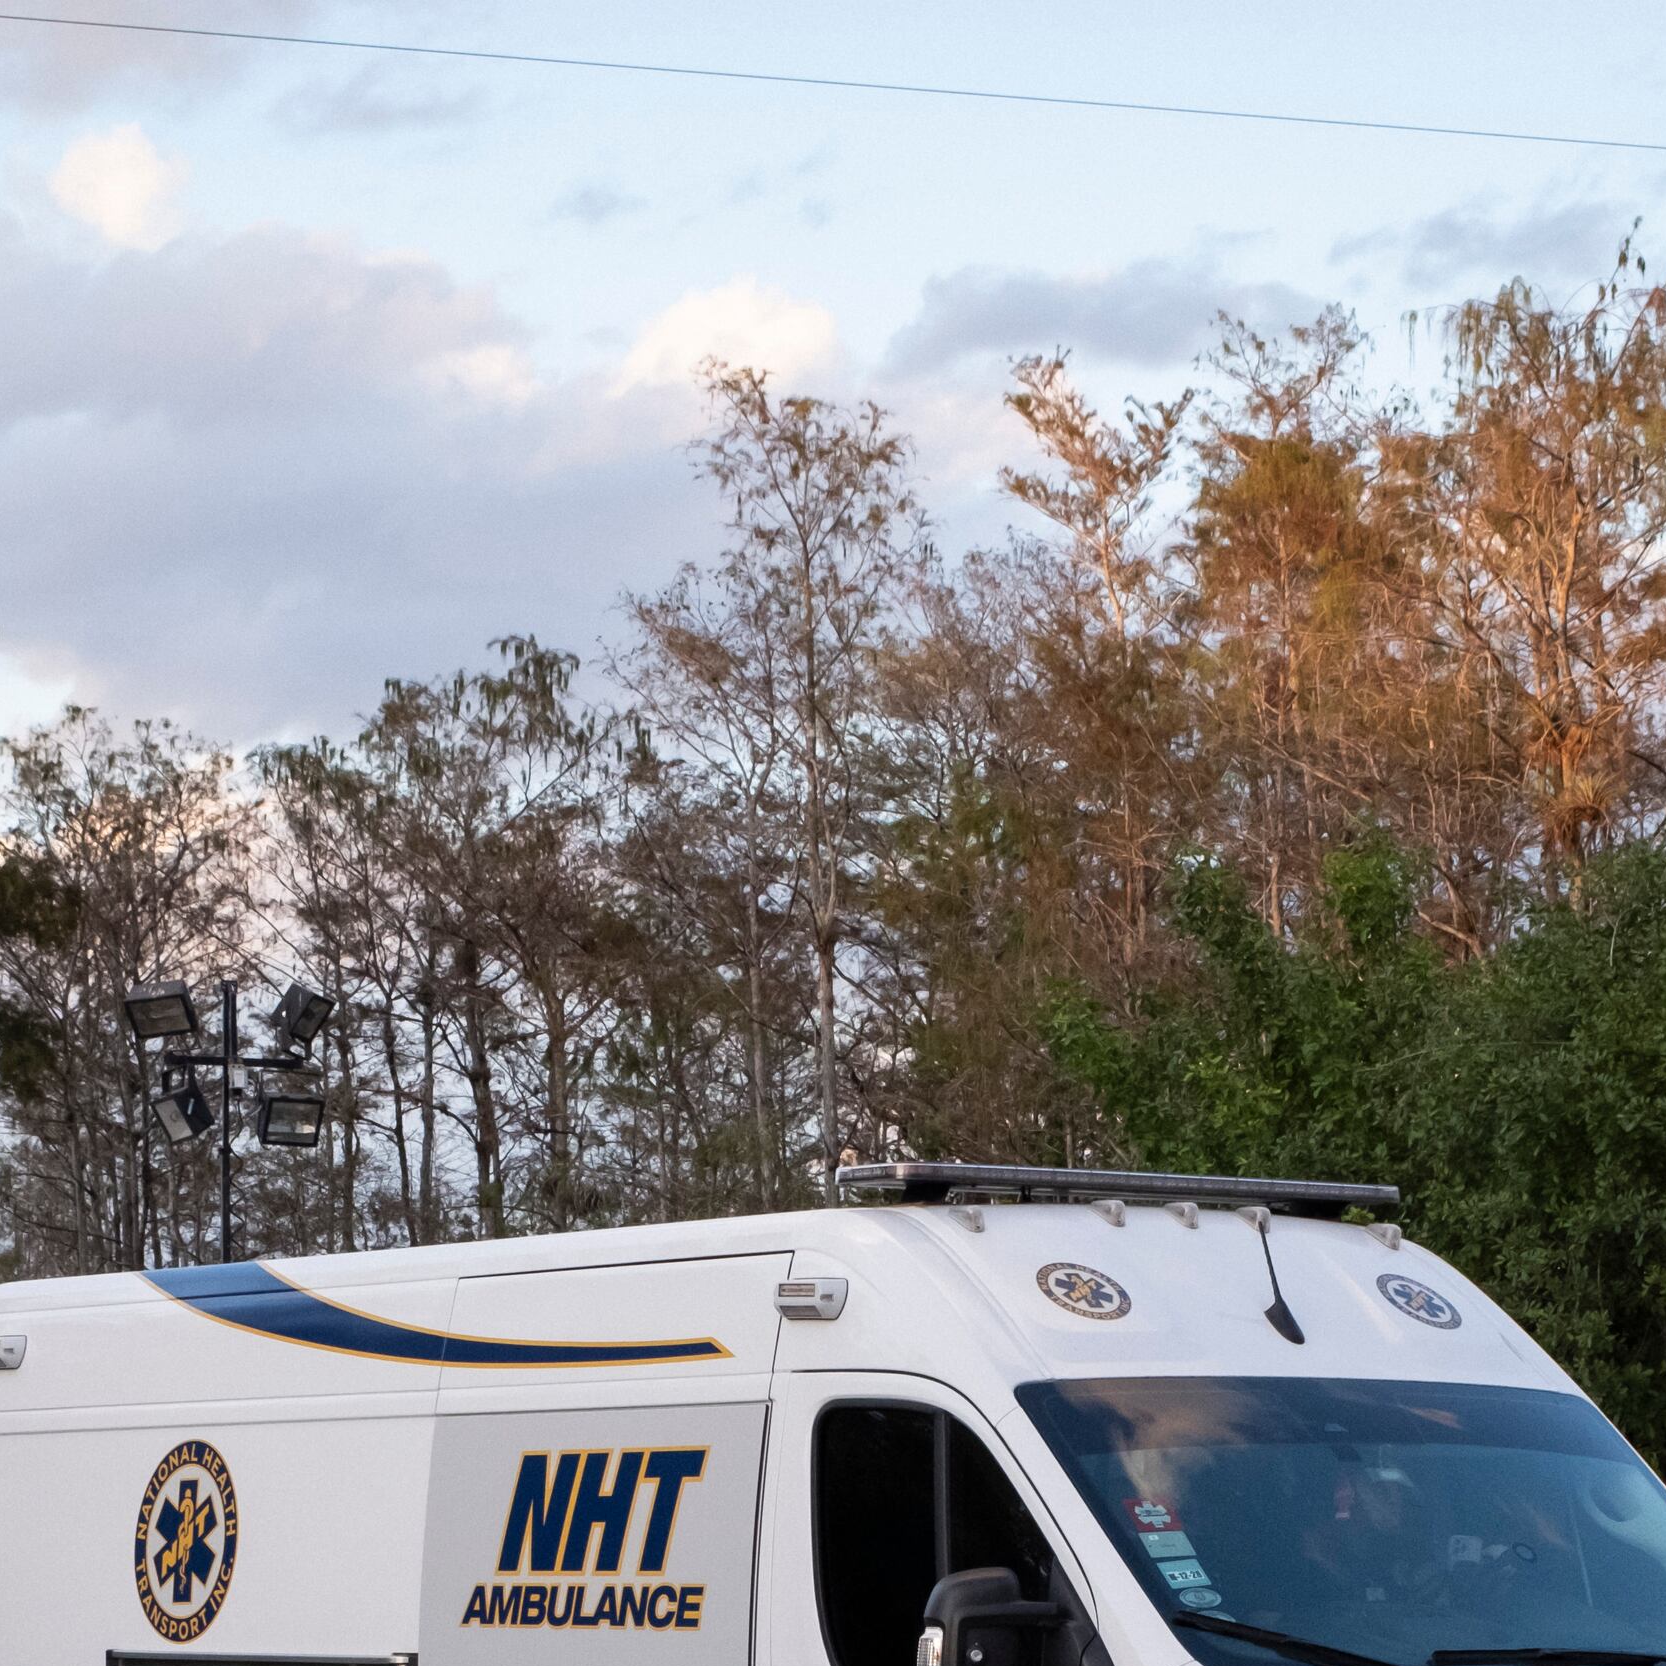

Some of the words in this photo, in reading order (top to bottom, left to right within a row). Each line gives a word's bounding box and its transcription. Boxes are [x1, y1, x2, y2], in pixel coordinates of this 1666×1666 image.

[136, 1443, 198, 1541] NATIONAL
[203, 1446, 237, 1537] HEALTH
[494, 1444, 712, 1576] NHT
[160, 1503, 211, 1578] NHT
[135, 1560, 208, 1640] TRANSPORT
[210, 1555, 235, 1612] INC.
[460, 1582, 708, 1632] AMBULANCE
